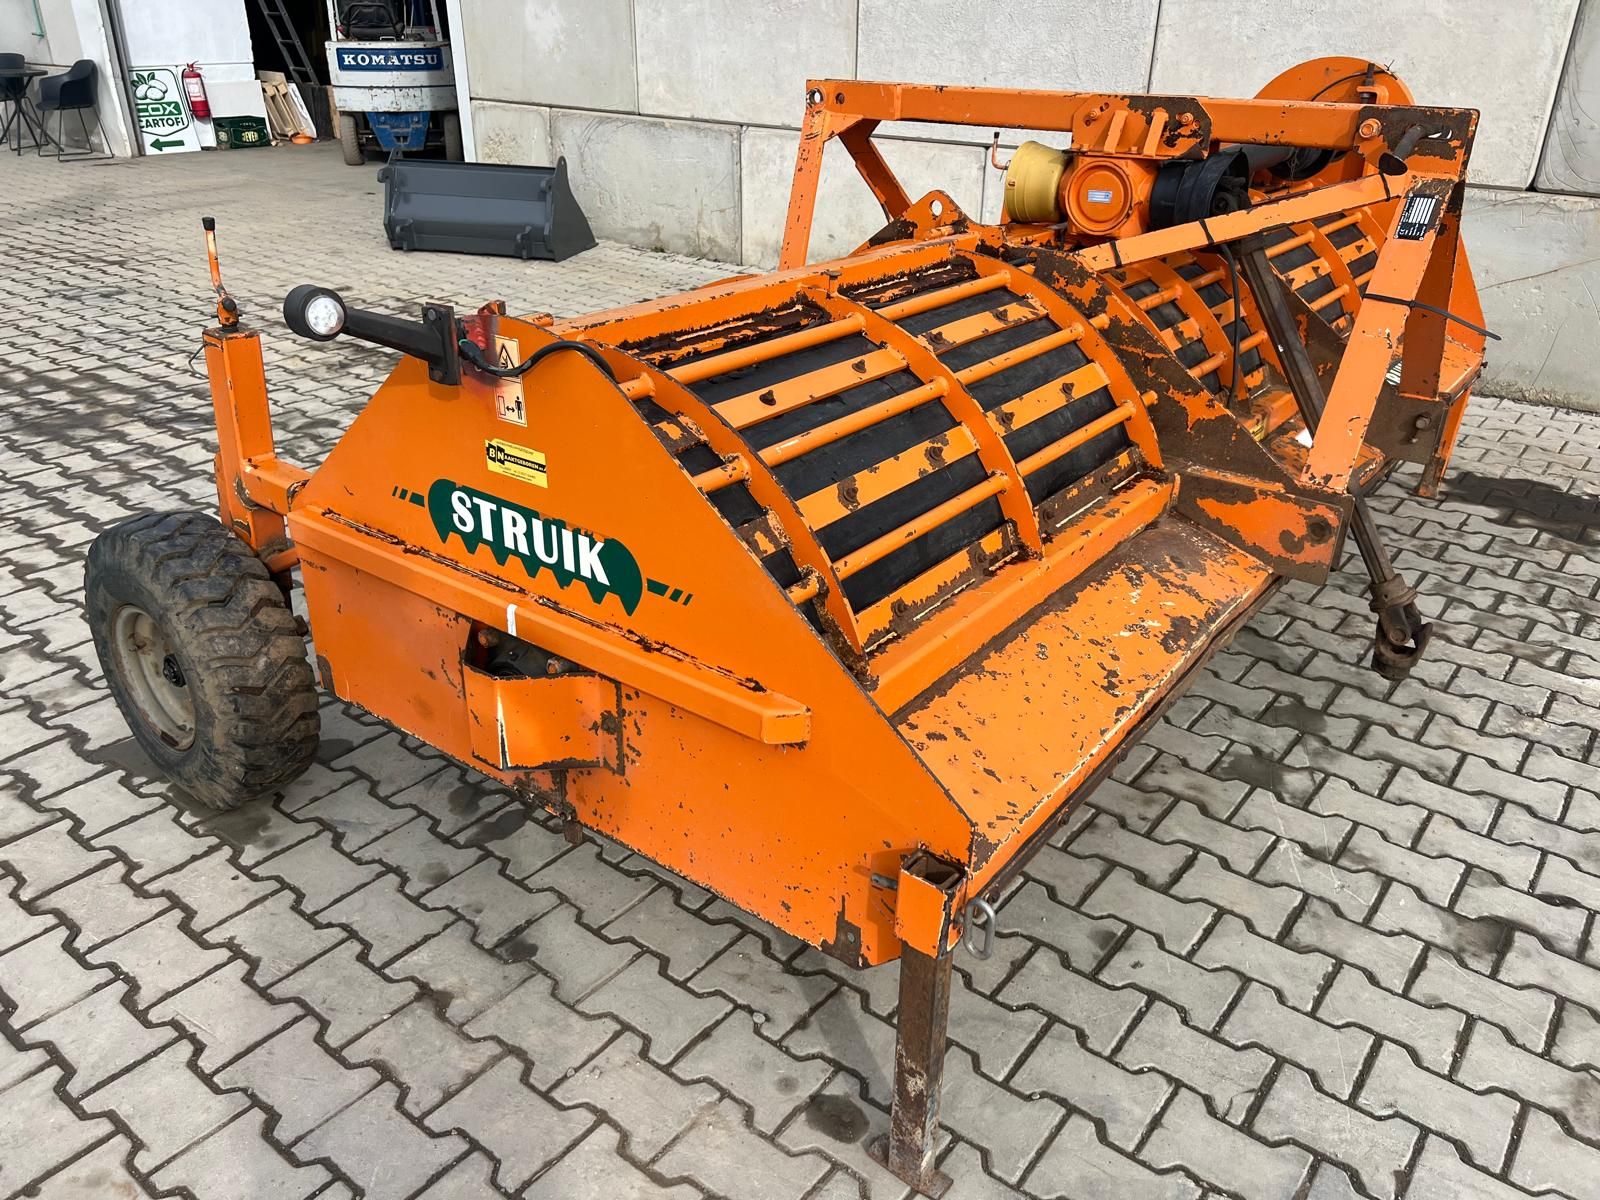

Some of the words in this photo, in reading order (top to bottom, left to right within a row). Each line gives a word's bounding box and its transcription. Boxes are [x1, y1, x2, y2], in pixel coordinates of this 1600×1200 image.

[342, 54, 438, 65] KOMATSU
[138, 117, 186, 129] CARTOFI
[450, 490, 611, 586] STRUIK
